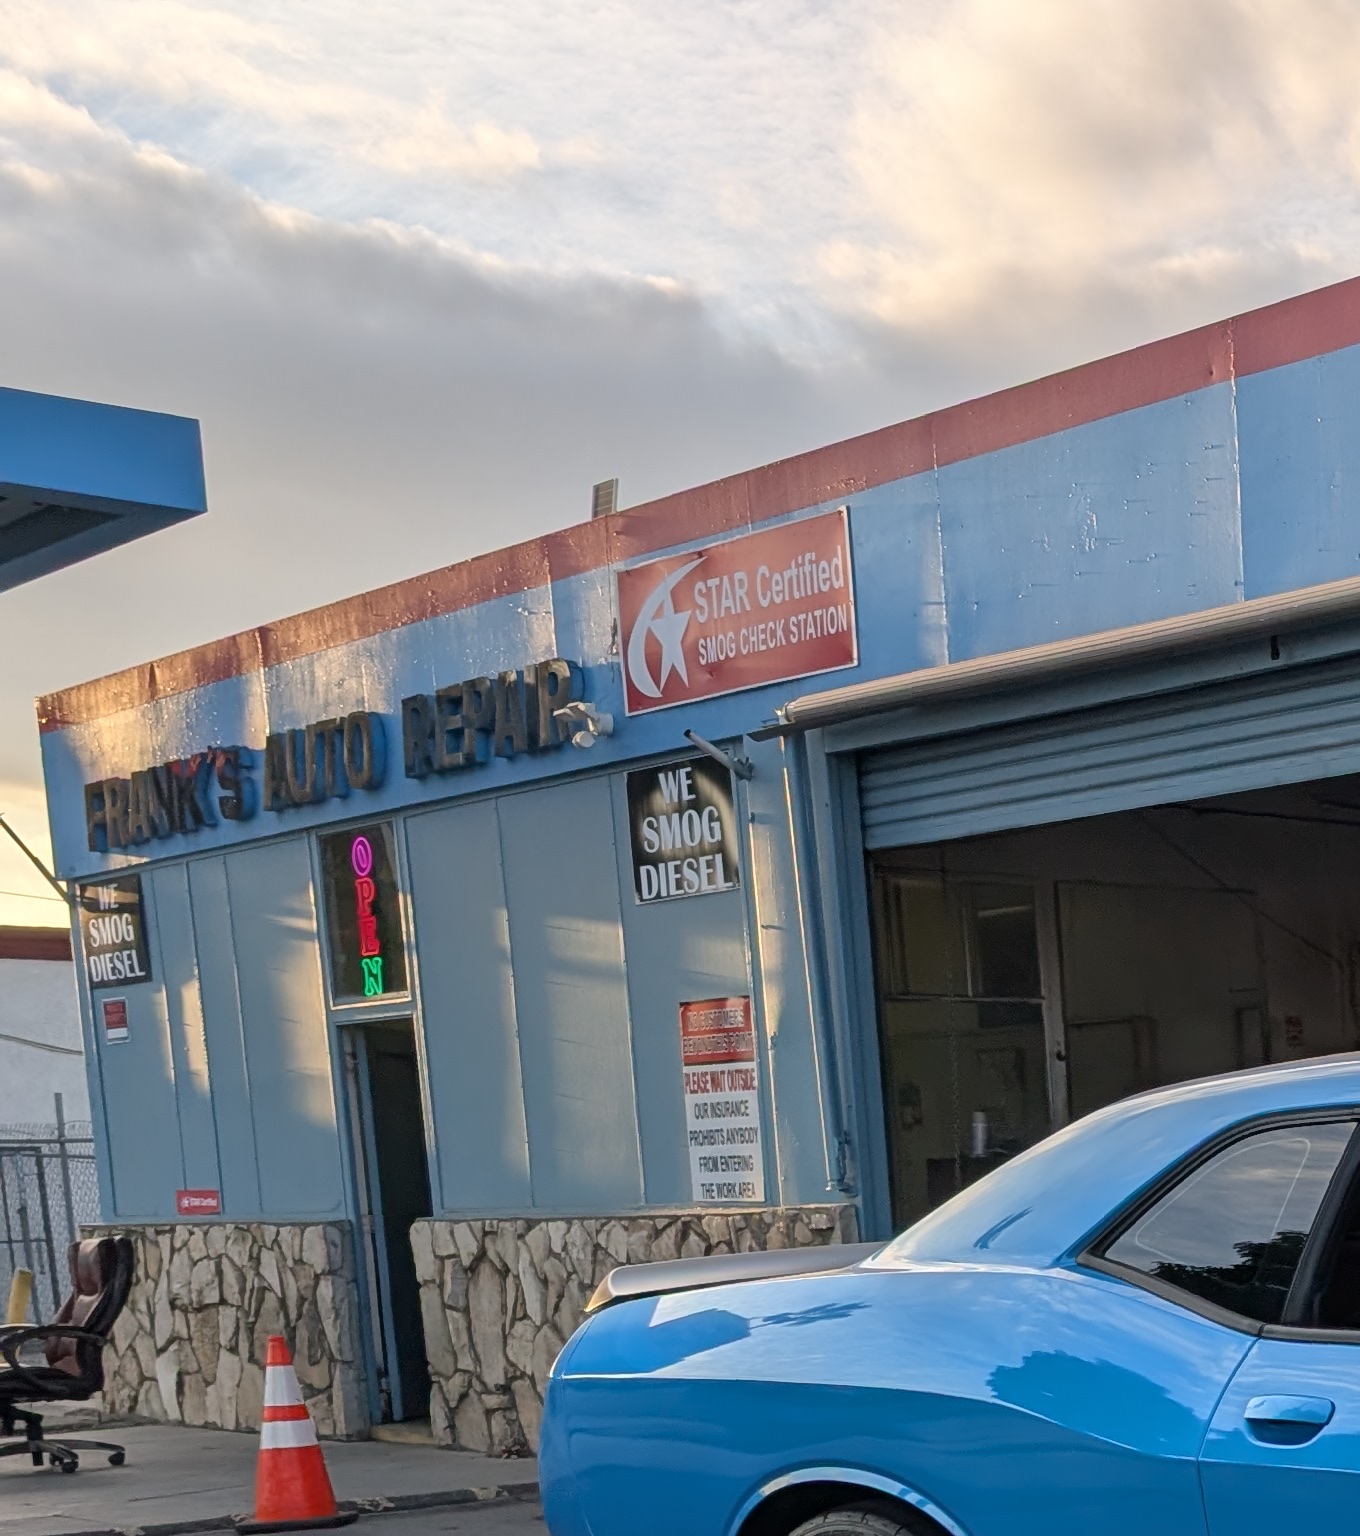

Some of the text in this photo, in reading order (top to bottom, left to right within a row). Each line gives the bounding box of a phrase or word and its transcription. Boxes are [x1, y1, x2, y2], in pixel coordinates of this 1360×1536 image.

[694, 545, 844, 623] STAR Certified
[698, 603, 848, 666] SMOG CHECK STATION
[84, 657, 582, 853] FRANK'S AUTO REPAIR
[658, 767, 696, 804] WE
[642, 806, 721, 853] SMOG
[639, 853, 733, 900] DIESEL
[98, 883, 119, 911] WE
[89, 913, 135, 948] SMOG
[352, 837, 383, 996] OPEN
[89, 950, 146, 982] DIESEL
[684, 1068, 756, 1095] PLEASE WAIT OUTSIDE
[694, 1100, 749, 1119] OUR INSURANCE
[689, 1126, 758, 1147] PROHIBITS ANYBODY
[699, 1155, 753, 1173] FROM ENTERING
[701, 1181, 756, 1199] THE WORK AREA
